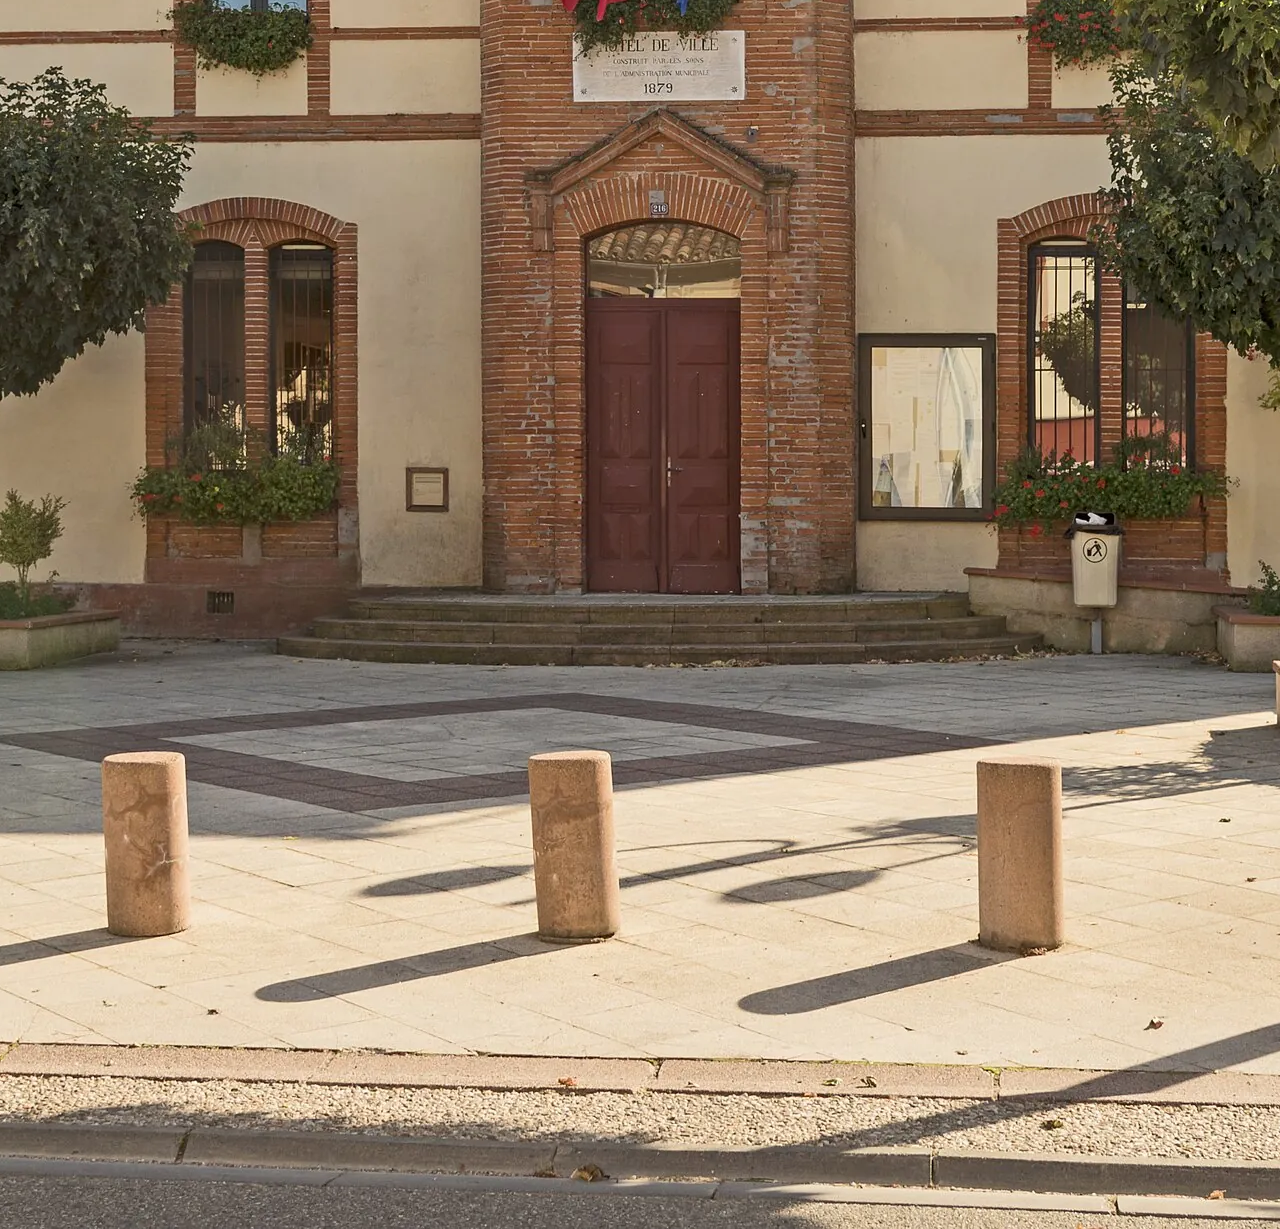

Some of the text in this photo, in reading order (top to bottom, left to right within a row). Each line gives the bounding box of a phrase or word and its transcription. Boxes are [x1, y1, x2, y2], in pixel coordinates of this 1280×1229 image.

[652, 38, 670, 52] DE
[678, 37, 719, 52] VILLE
[644, 82, 673, 93] 1879
[653, 204, 666, 212] 216
